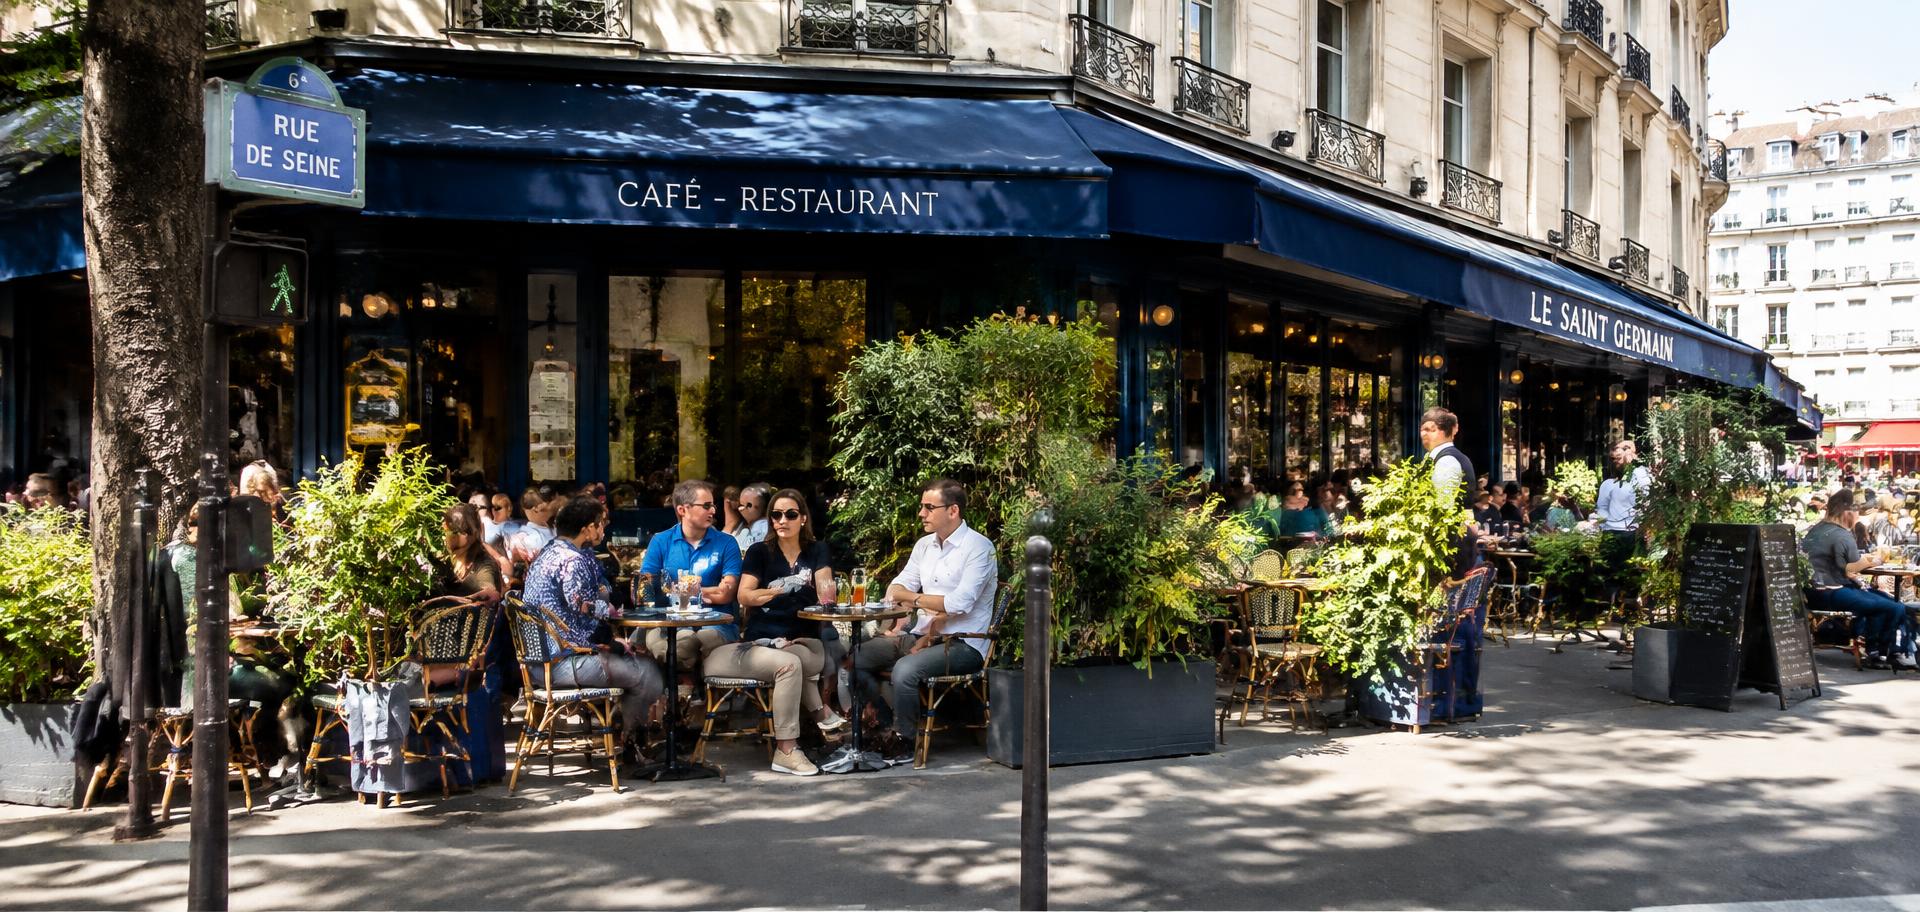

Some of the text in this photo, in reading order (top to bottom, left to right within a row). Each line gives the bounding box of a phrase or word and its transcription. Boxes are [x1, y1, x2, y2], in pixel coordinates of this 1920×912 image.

[274, 113, 320, 143] RUE
[246, 143, 341, 179] DE SEINE
[617, 178, 701, 210] CAFÉ
[740, 186, 939, 217] RESTAURANT
[1530, 291, 1674, 363] LE SAINT GERMAIN
